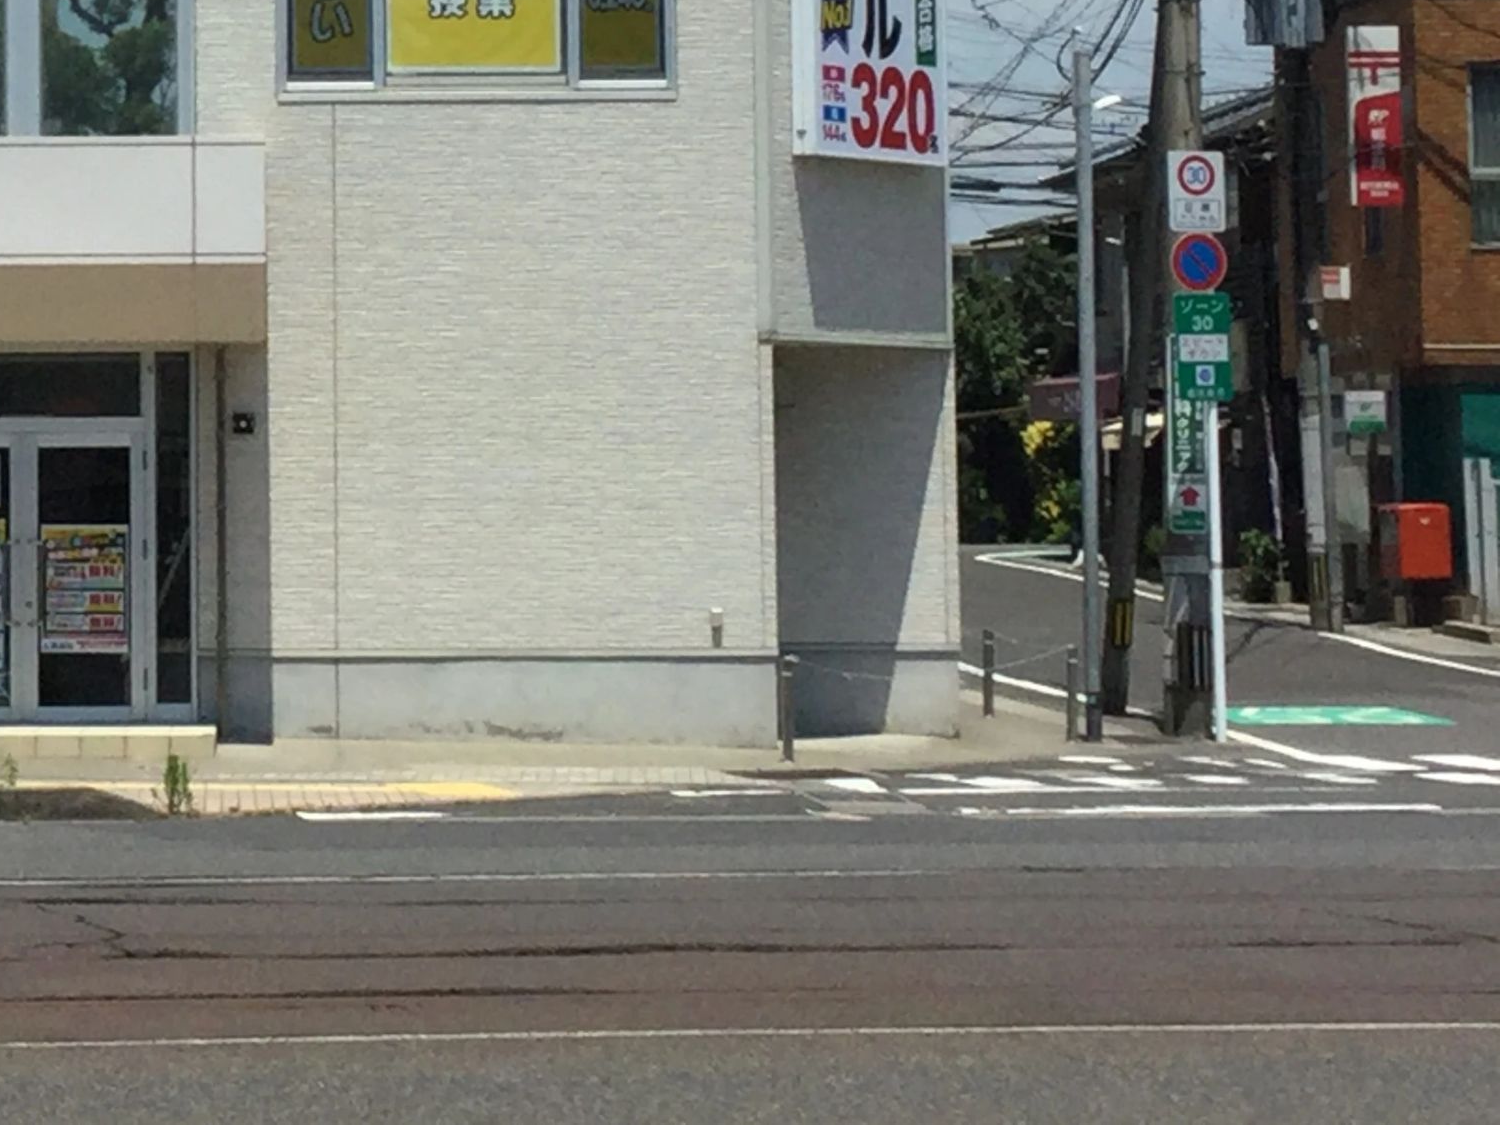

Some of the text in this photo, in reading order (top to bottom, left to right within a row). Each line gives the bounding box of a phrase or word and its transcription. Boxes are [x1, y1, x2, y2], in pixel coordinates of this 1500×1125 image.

[1187, 165, 1206, 184] 30
[1180, 299, 1225, 313] ゾーン
[1191, 316, 1214, 331] 30
